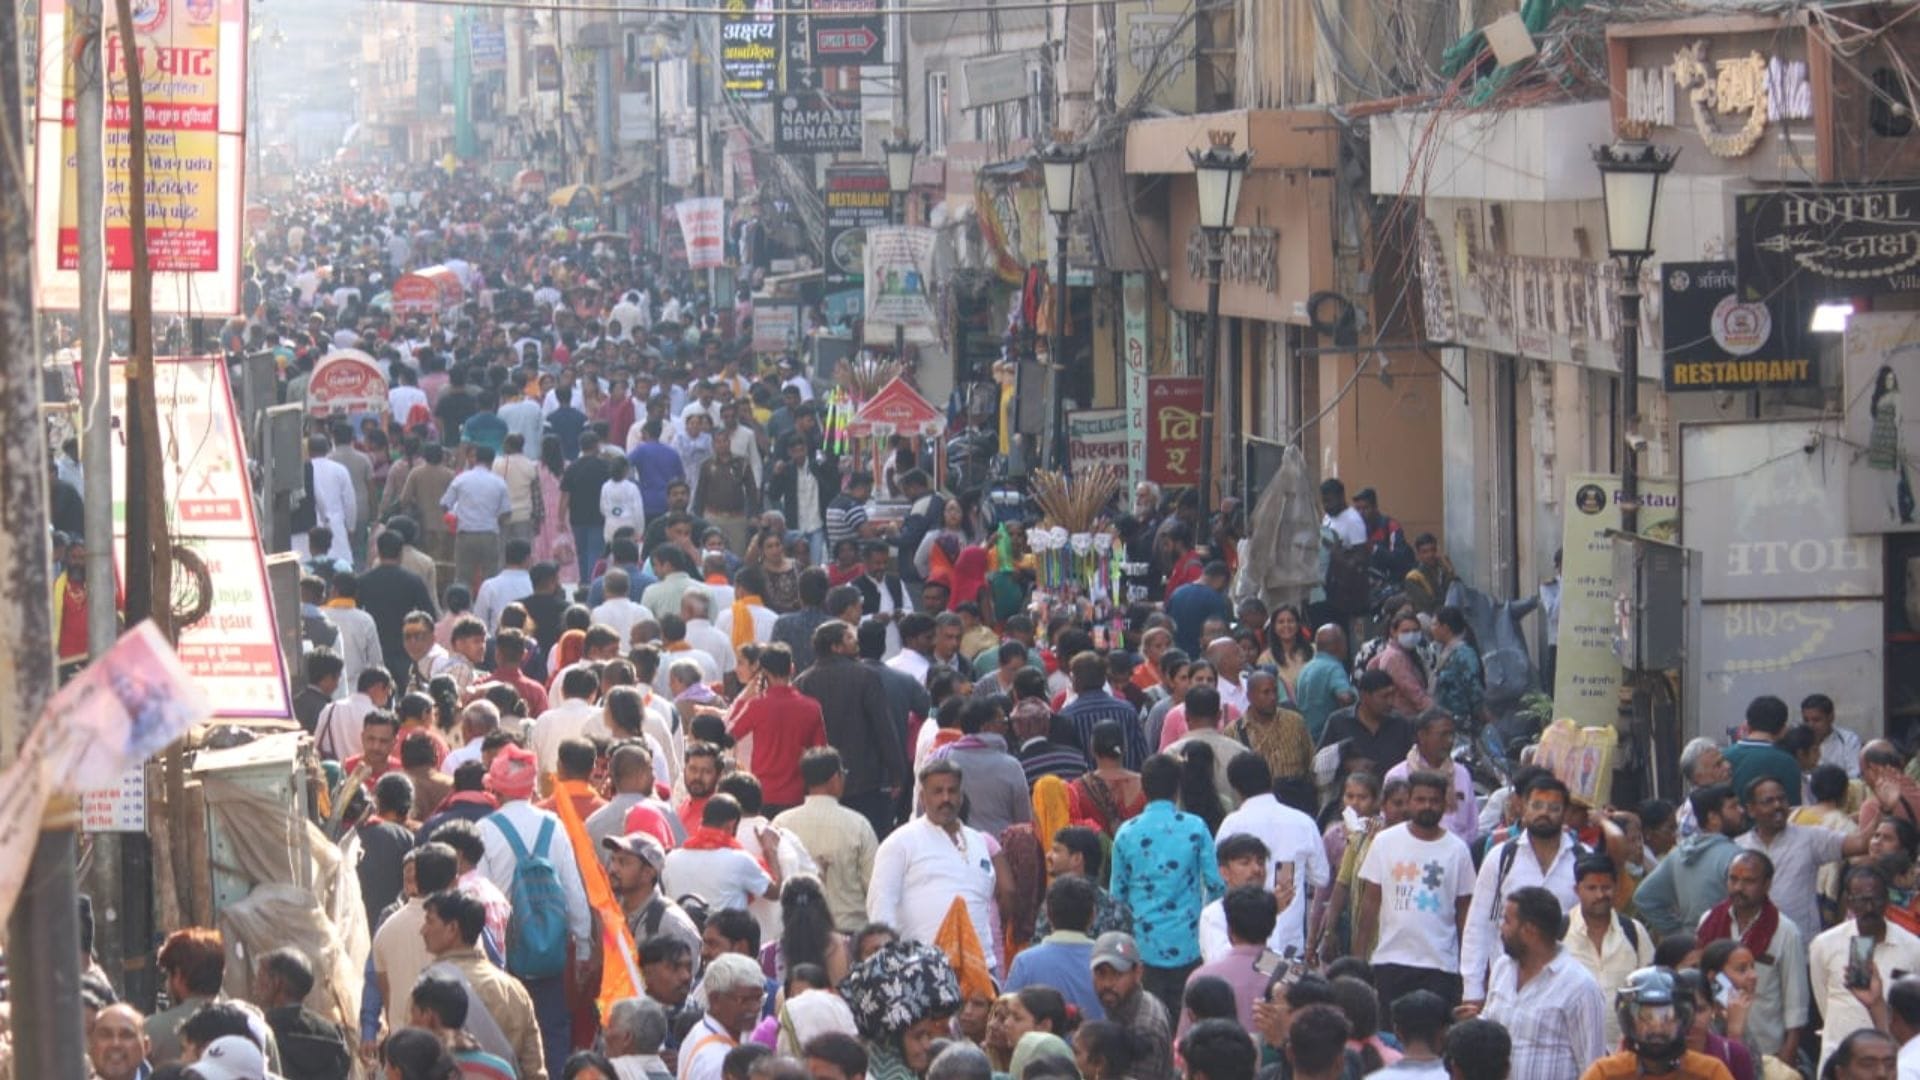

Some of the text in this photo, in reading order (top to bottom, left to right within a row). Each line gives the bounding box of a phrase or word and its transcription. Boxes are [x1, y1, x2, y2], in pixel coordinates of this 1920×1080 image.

[156, 47, 214, 76] घाट
[829, 192, 889, 207] RESTAURANT
[1783, 193, 1910, 226] HOTEL
[1674, 359, 1809, 385] RESTAURANT
